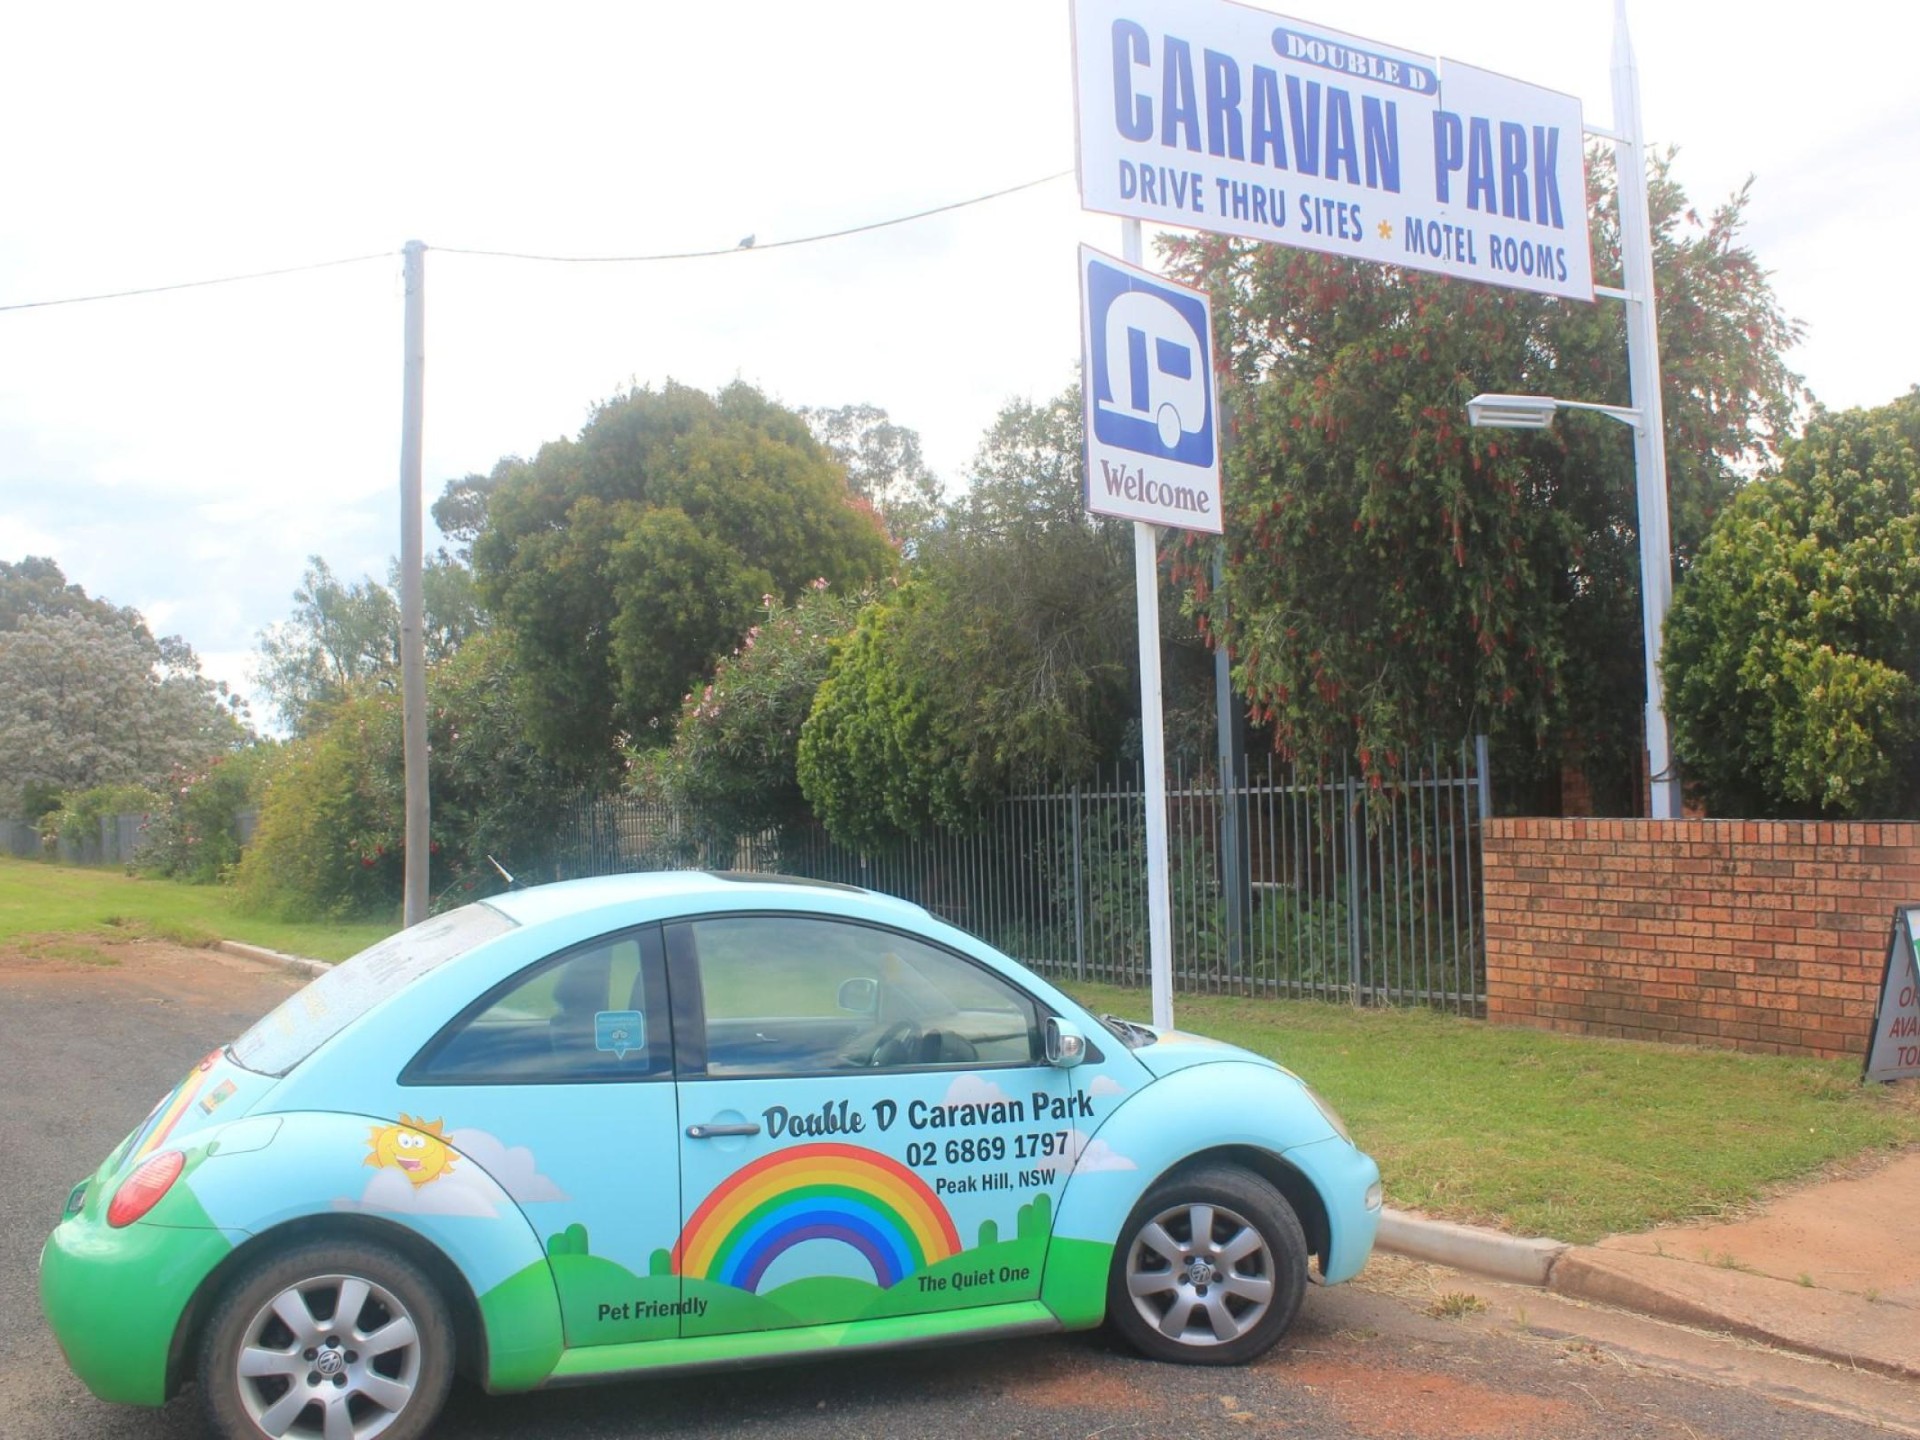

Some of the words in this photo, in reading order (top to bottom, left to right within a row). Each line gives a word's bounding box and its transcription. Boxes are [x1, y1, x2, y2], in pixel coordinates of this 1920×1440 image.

[1286, 33, 1400, 84] DOUBLE
[1409, 67, 1427, 91] D
[1111, 18, 1401, 194] CARAVAN
[1432, 110, 1565, 230] PARK
[1119, 159, 1204, 213] DRIVE
[1216, 178, 1287, 228] THRU
[1299, 195, 1363, 243] SITES
[1405, 216, 1477, 265] MOTEL
[1490, 234, 1568, 283] ROOMS
[1100, 459, 1211, 513] Welcome
[1889, 1016, 1920, 1038] AVA
[762, 1099, 866, 1139] Double
[872, 1098, 897, 1131] D
[908, 1095, 1025, 1130] Caravan
[1032, 1089, 1095, 1121] Park
[906, 1142, 937, 1168] 02
[945, 1136, 1006, 1164] 6869
[1014, 1131, 1069, 1160] 1797
[935, 1176, 977, 1195] Peak
[982, 1172, 1014, 1192] Hill,
[1018, 1169, 1056, 1187] NSW
[918, 1274, 947, 1293] The
[951, 1268, 995, 1290] Quiet
[999, 1266, 1030, 1284] One
[598, 1303, 630, 1321] Pet
[635, 1297, 708, 1319] Friendly
